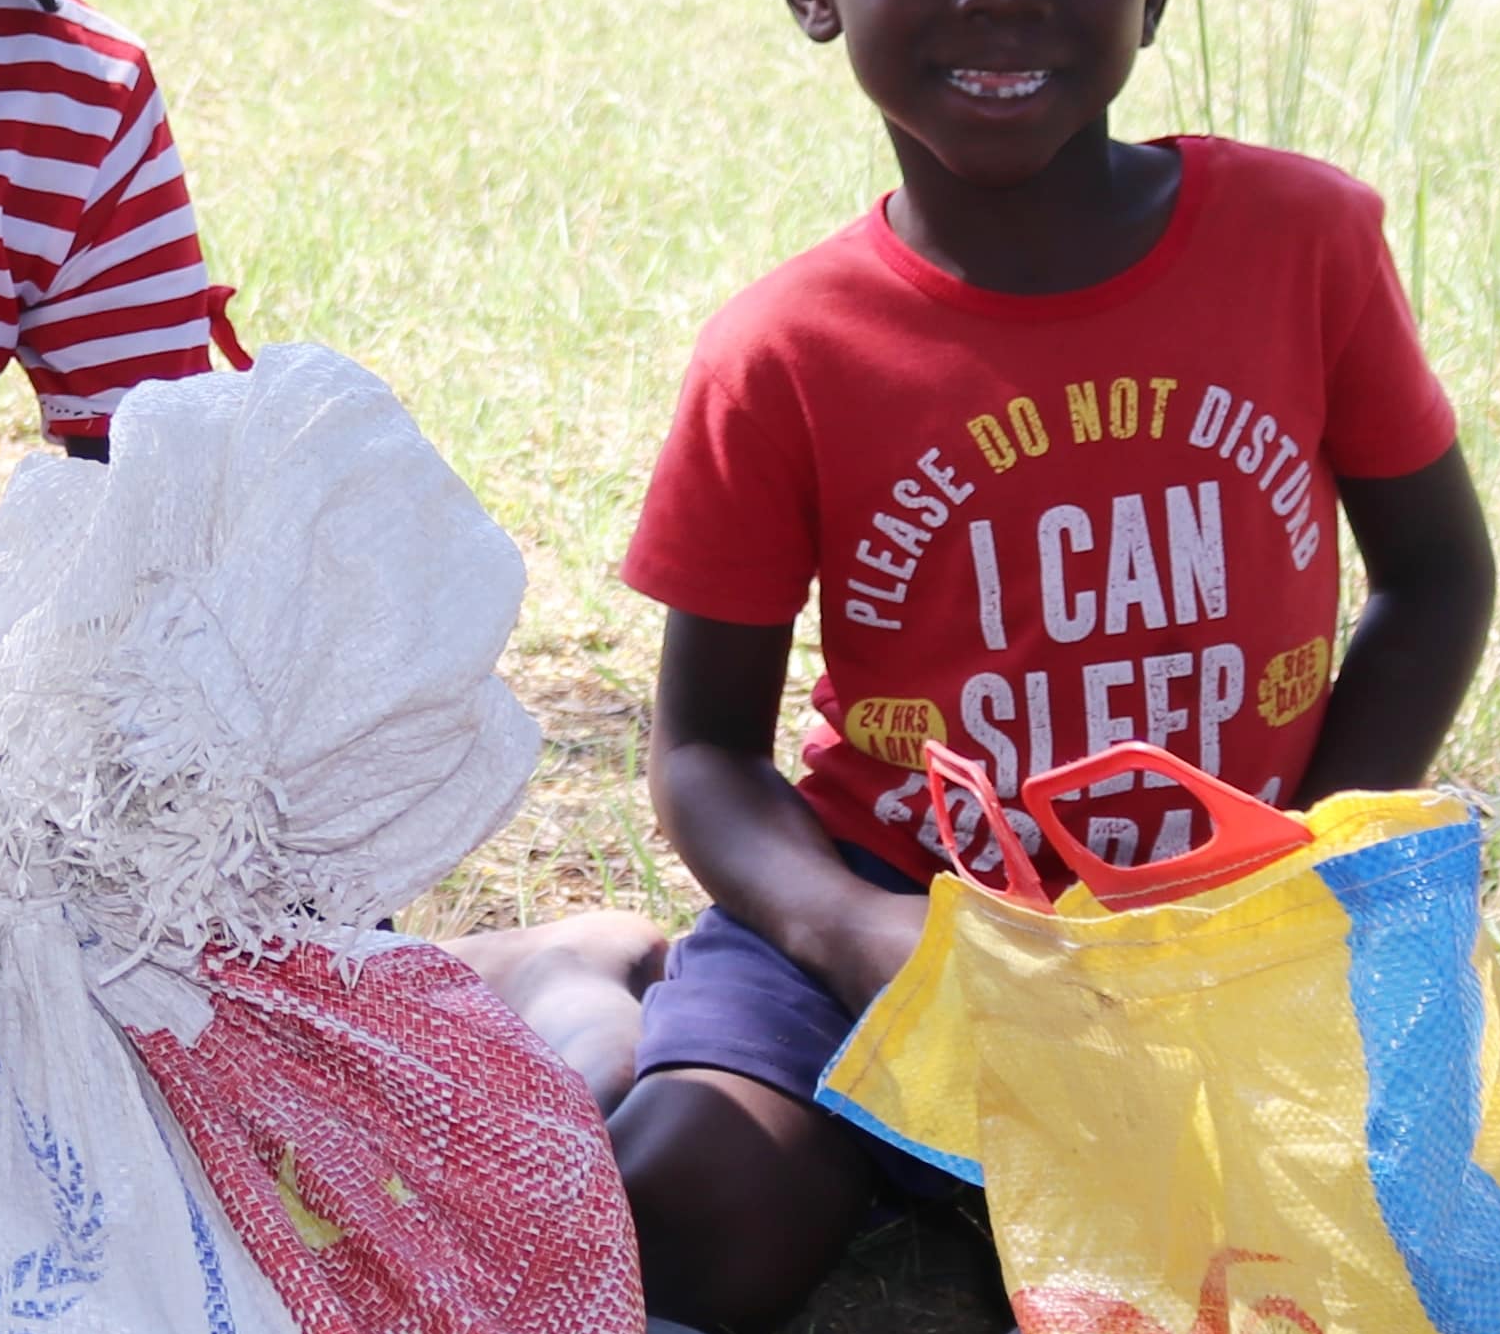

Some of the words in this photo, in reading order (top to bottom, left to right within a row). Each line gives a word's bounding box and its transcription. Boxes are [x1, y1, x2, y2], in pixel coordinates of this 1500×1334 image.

[845, 447, 976, 631] PLEASE
[966, 396, 1051, 474] DO
[1065, 376, 1178, 444] NOT
[1188, 384, 1322, 572] DISTURB
[968, 519, 1008, 651] I
[1037, 480, 1228, 644] CAN
[858, 702, 887, 729] 24
[890, 704, 929, 733] HRS
[960, 643, 1246, 800] SLEEP
